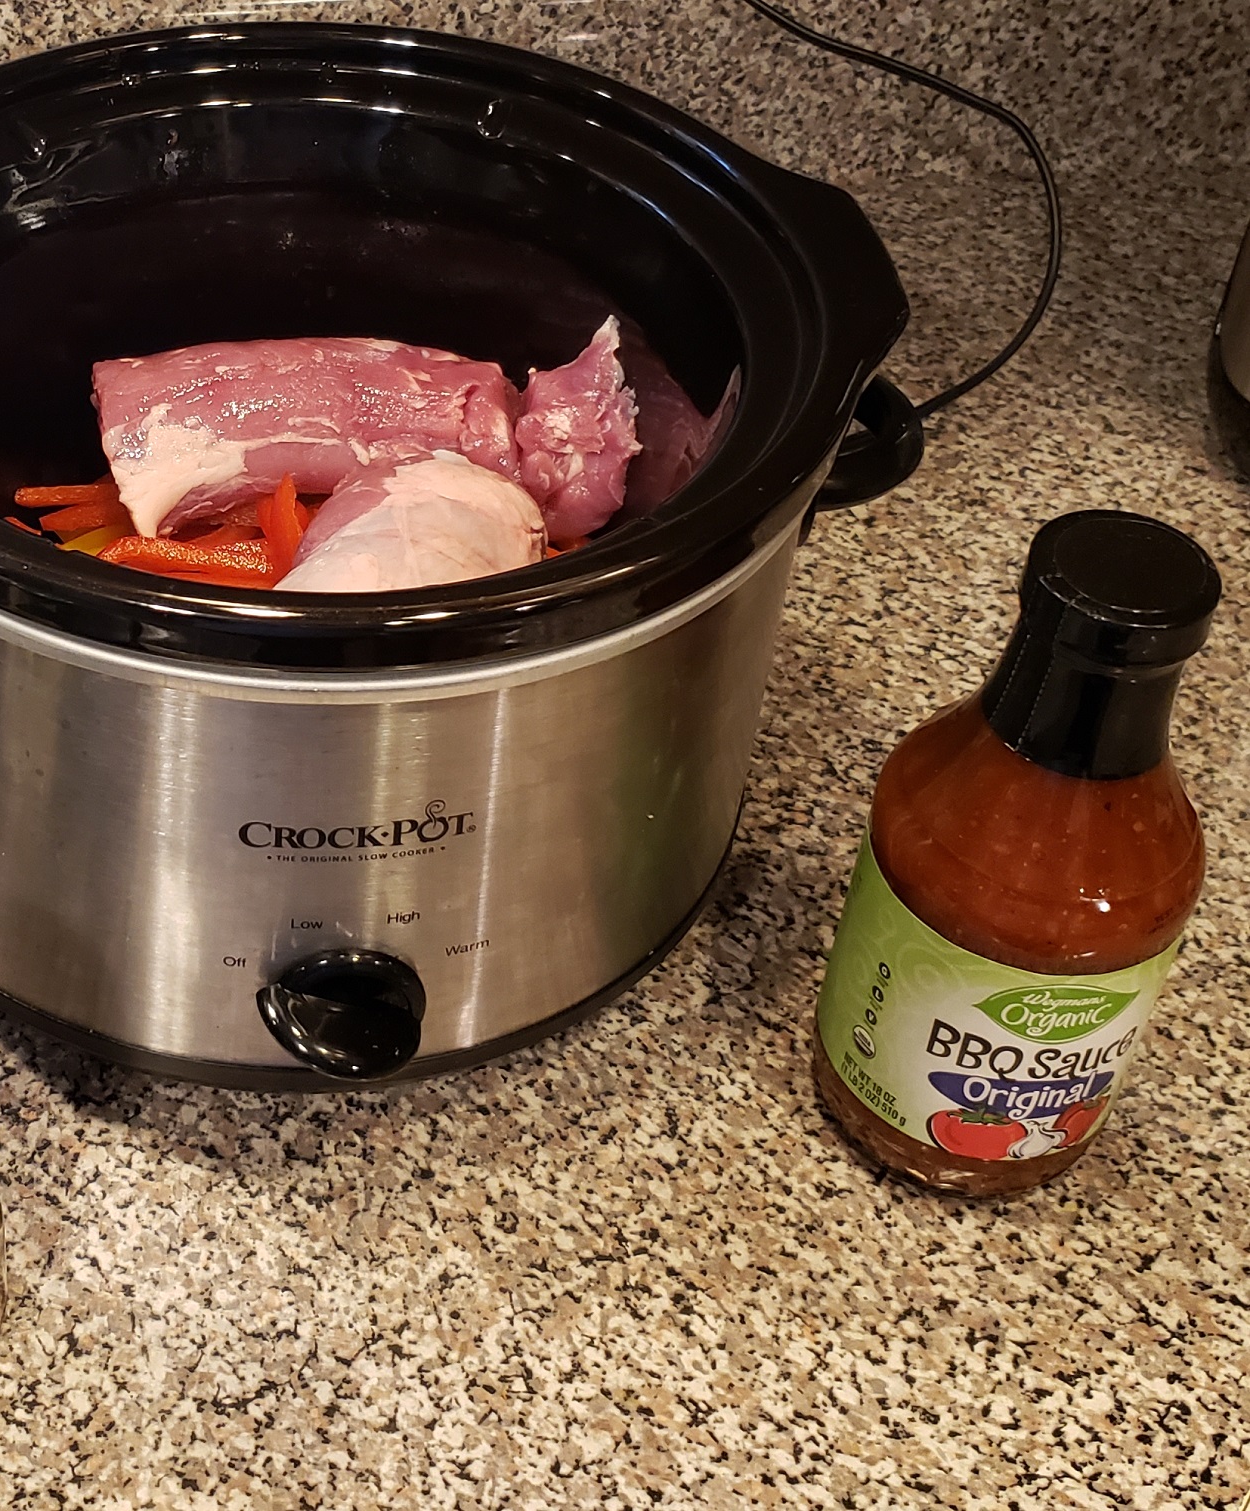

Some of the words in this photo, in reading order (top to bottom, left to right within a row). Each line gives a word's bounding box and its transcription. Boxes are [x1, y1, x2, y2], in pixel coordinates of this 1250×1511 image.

[276, 854, 296, 862] THE
[301, 855, 352, 863] ORIGINAL
[358, 853, 388, 861] SLOW
[392, 847, 434, 859] COOKER
[291, 918, 323, 929] Low
[386, 910, 420, 924] High
[445, 938, 490, 957] Warm
[223, 956, 247, 968] Off
[1001, 1003, 1112, 1037] Organic
[926, 1019, 1023, 1082] BBQ
[848, 1071, 858, 1086] LB
[858, 1082, 865, 1093] 2
[865, 1089, 880, 1107] OZ)
[881, 1102, 898, 1119] 510
[858, 1067, 871, 1085] WT
[873, 1082, 883, 1096] 18
[883, 1091, 897, 1106] OZ
[963, 1071, 1098, 1120] Original
